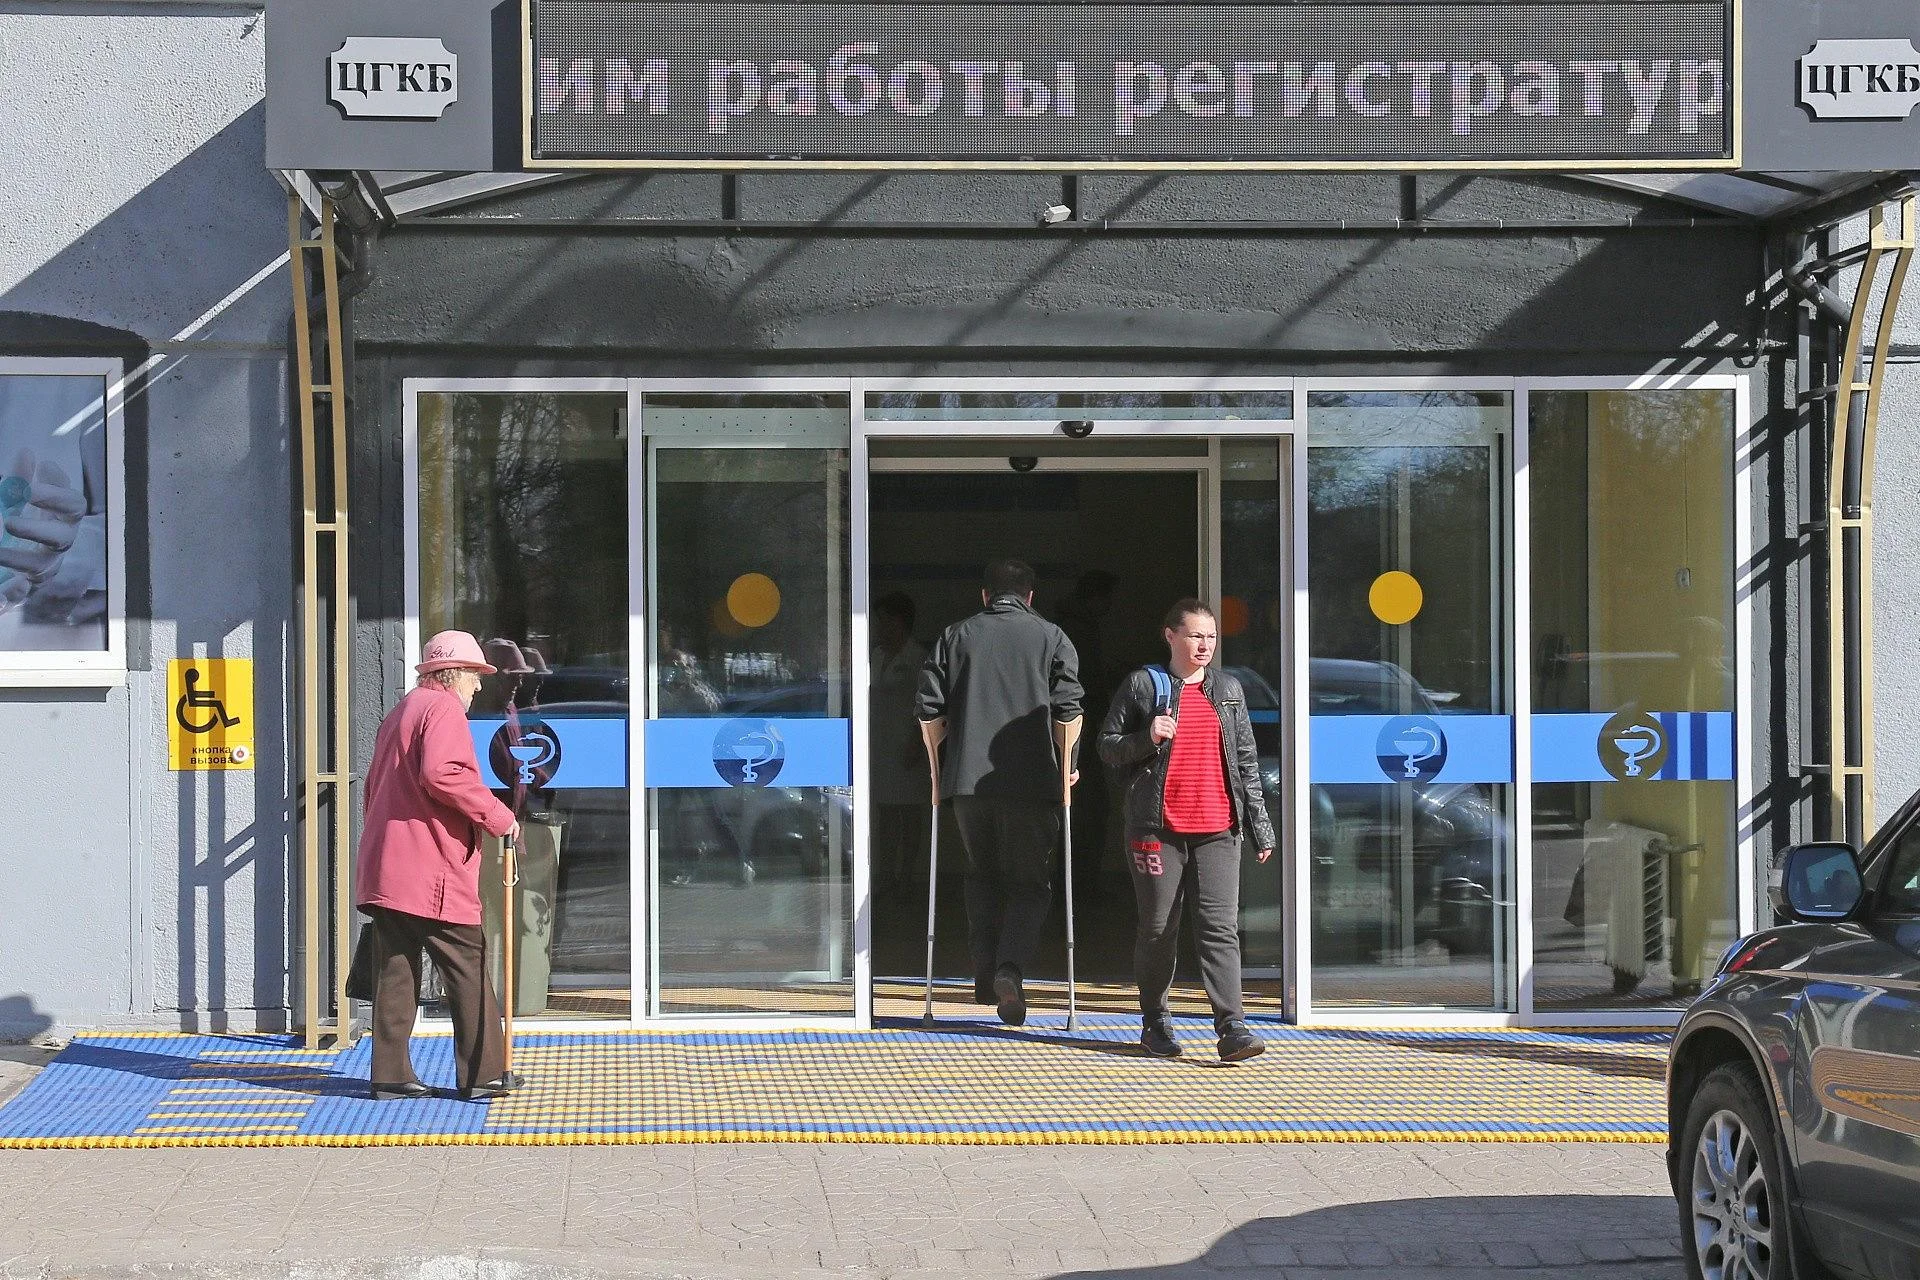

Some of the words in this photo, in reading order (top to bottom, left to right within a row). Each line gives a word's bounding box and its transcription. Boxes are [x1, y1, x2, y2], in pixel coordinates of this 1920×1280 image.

[337, 61, 453, 99] ЦГКБ
[540, 58, 669, 115] им
[707, 42, 1077, 135] работы
[1115, 60, 1723, 135] регистратур
[1806, 63, 1920, 101] ЦГКБ
[190, 756, 233, 765] вызова
[192, 746, 231, 755] кнопка
